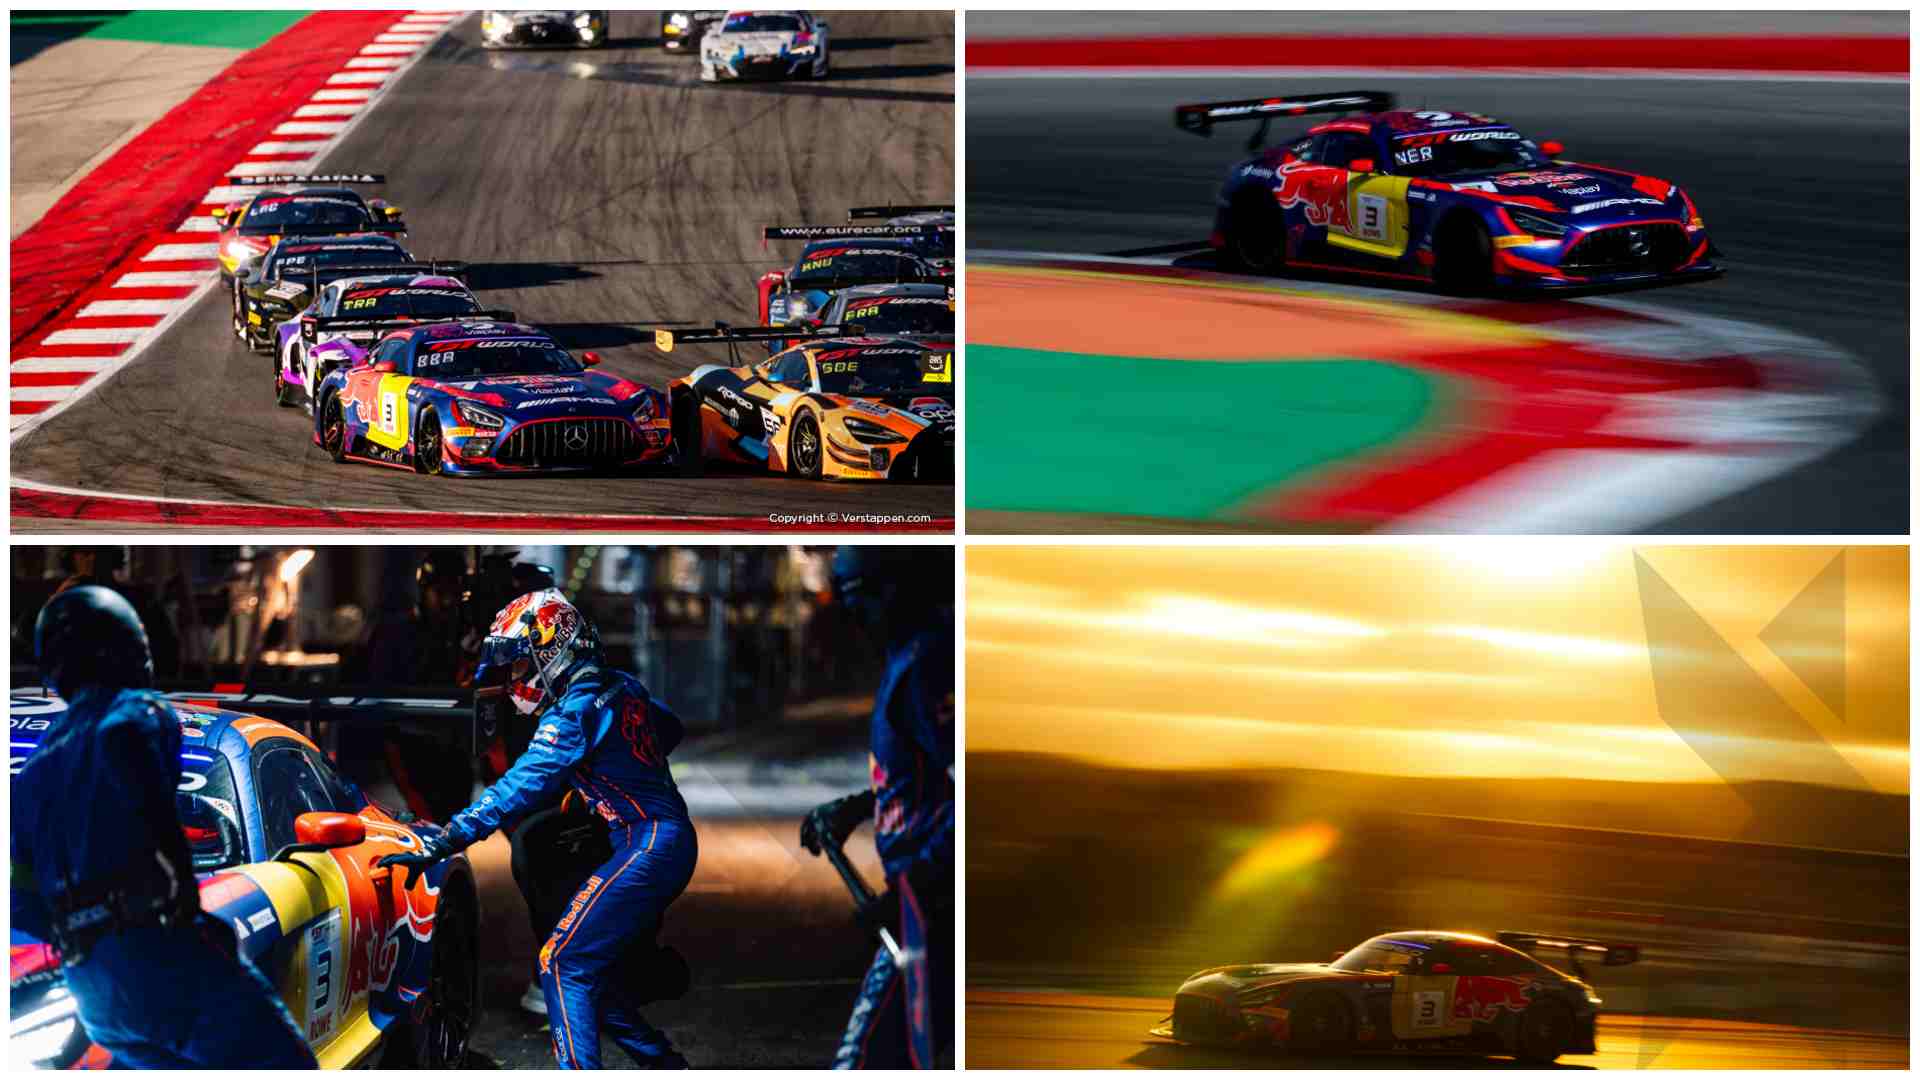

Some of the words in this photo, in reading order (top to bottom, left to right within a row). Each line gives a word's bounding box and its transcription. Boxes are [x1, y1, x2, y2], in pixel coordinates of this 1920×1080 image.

[1449, 132, 1520, 141] WORLD
[1364, 206, 1377, 226] 3
[478, 341, 556, 349] WORLD
[386, 404, 393, 421] 3
[556, 899, 585, 931] Red
[314, 950, 332, 1010] 3
[1421, 1000, 1434, 1017] 3
